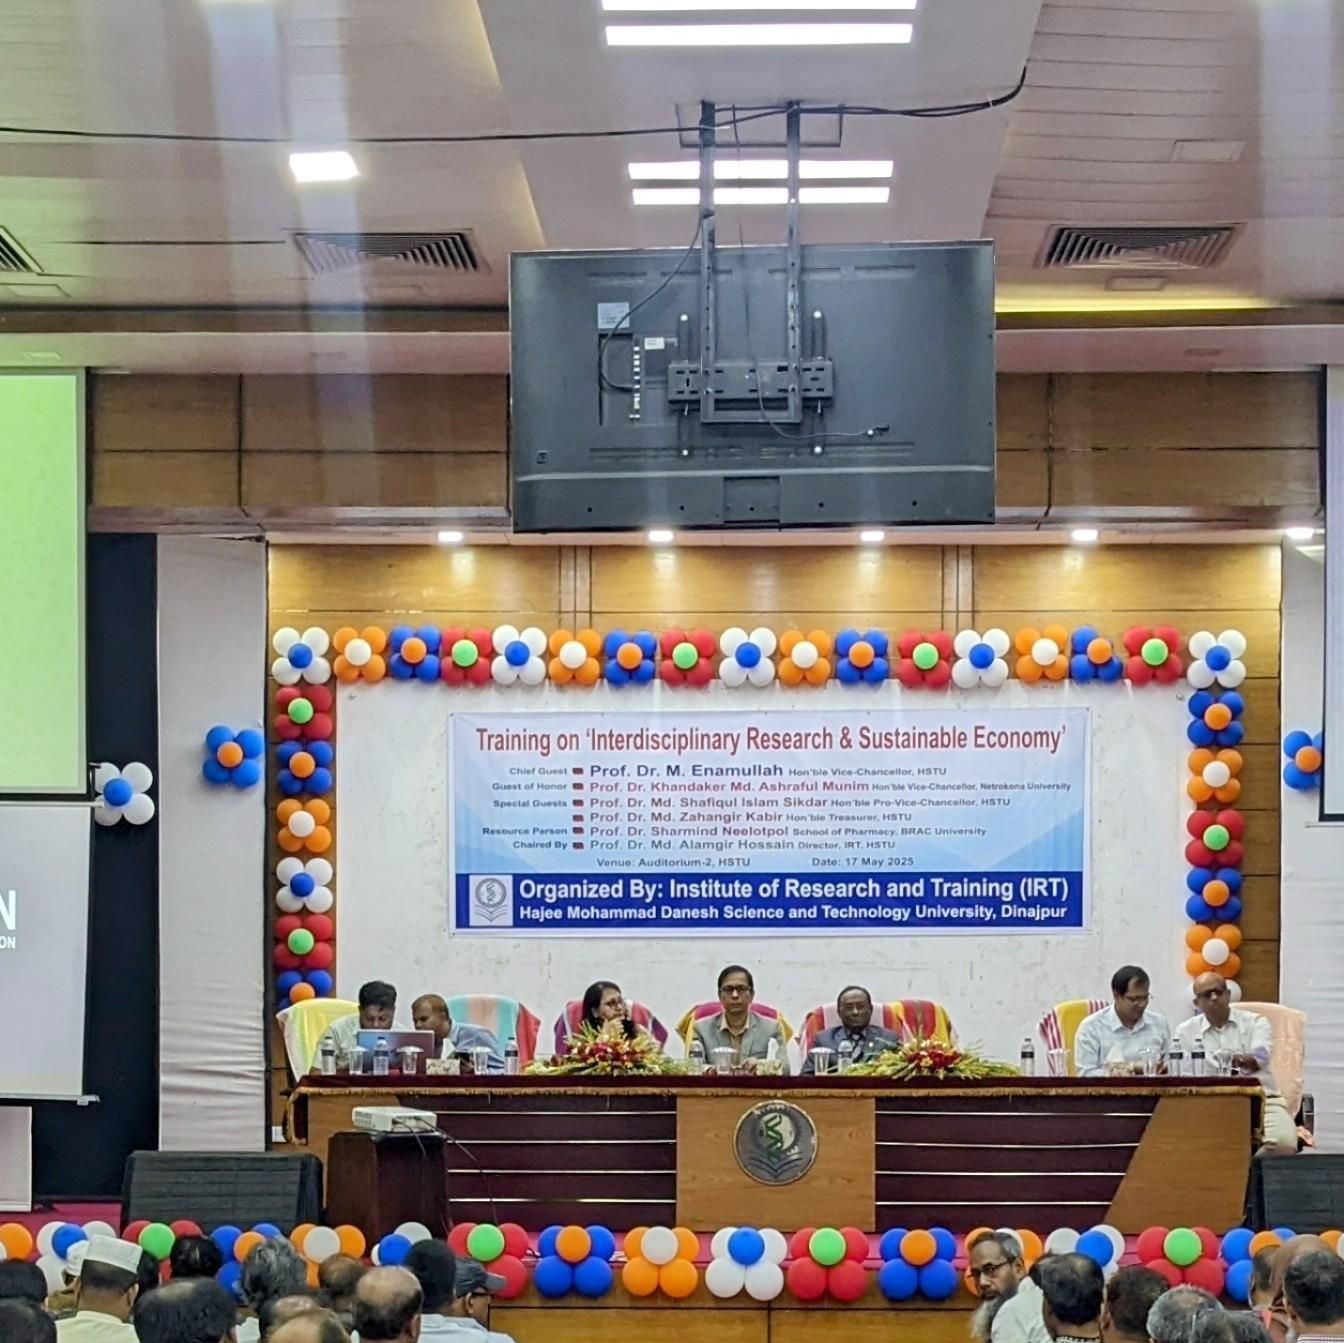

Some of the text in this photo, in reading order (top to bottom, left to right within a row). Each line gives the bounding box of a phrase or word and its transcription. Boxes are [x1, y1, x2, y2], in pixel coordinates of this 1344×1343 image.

[476, 728, 551, 757] Training
[557, 733, 579, 751] on
[747, 726, 833, 750] Research
[839, 726, 853, 750] &
[859, 725, 967, 750] Sustainable
[509, 767, 536, 776] Chief
[539, 767, 568, 776] Guest
[590, 765, 631, 777] Prof.
[637, 765, 661, 777] Dr.
[666, 765, 685, 777] M.
[692, 764, 783, 777] Enamullah
[830, 767, 915, 777] Vice-Chancellor,
[917, 767, 946, 776] HSTU
[492, 782, 521, 791] Guest
[524, 782, 535, 791] of
[537, 782, 568, 791] Honor
[590, 782, 623, 792] Prof.
[627, 782, 646, 792] Dr.
[651, 782, 726, 792] Khandaker
[730, 782, 755, 792] Md.
[759, 781, 818, 792] Ashraful
[822, 781, 869, 792] Munim
[1027, 782, 1071, 792] University
[493, 800, 529, 809] Special
[533, 799, 568, 808] Guests
[590, 798, 623, 808] Prof.
[627, 798, 646, 808] Dr.
[651, 798, 675, 808] Md.
[679, 797, 737, 810] Shafiqul
[742, 797, 779, 807] Islam
[783, 797, 828, 807] Sikdar
[981, 799, 1010, 807] HSTU
[590, 812, 623, 822] Prof.
[627, 812, 646, 822] Dr.
[651, 812, 675, 822] Md.
[679, 811, 742, 824] Zahangir
[746, 811, 783, 822] Kabir
[828, 814, 880, 822] Treasurer,
[882, 813, 912, 821] HSTU
[482, 827, 530, 835] Resource
[533, 827, 568, 835] Person
[590, 826, 623, 837] Prof.
[627, 826, 646, 837] Dr.
[651, 826, 718, 836] Sharmind
[722, 826, 788, 838] Neelotpol
[793, 828, 828, 836] School
[831, 828, 841, 836] of
[901, 827, 931, 836] BRAC
[935, 827, 986, 837] University
[513, 841, 552, 849] Chaired
[555, 841, 568, 851] By
[590, 839, 623, 850] Prof.
[627, 839, 646, 850] Dr.
[651, 839, 675, 850] Md.
[679, 839, 734, 851] Alamgir
[738, 839, 795, 850] Hossain
[866, 841, 895, 849] HSTU
[597, 857, 750, 868] Venue: Auditorium-2, HSTU
[812, 857, 914, 867] Date: 17 May 2025
[519, 877, 1068, 903] Organized By: Institute of Research and Training (IRT)
[520, 904, 1067, 922] Hajee Mohammad Danesh Science and Technology University, Dinajpur
